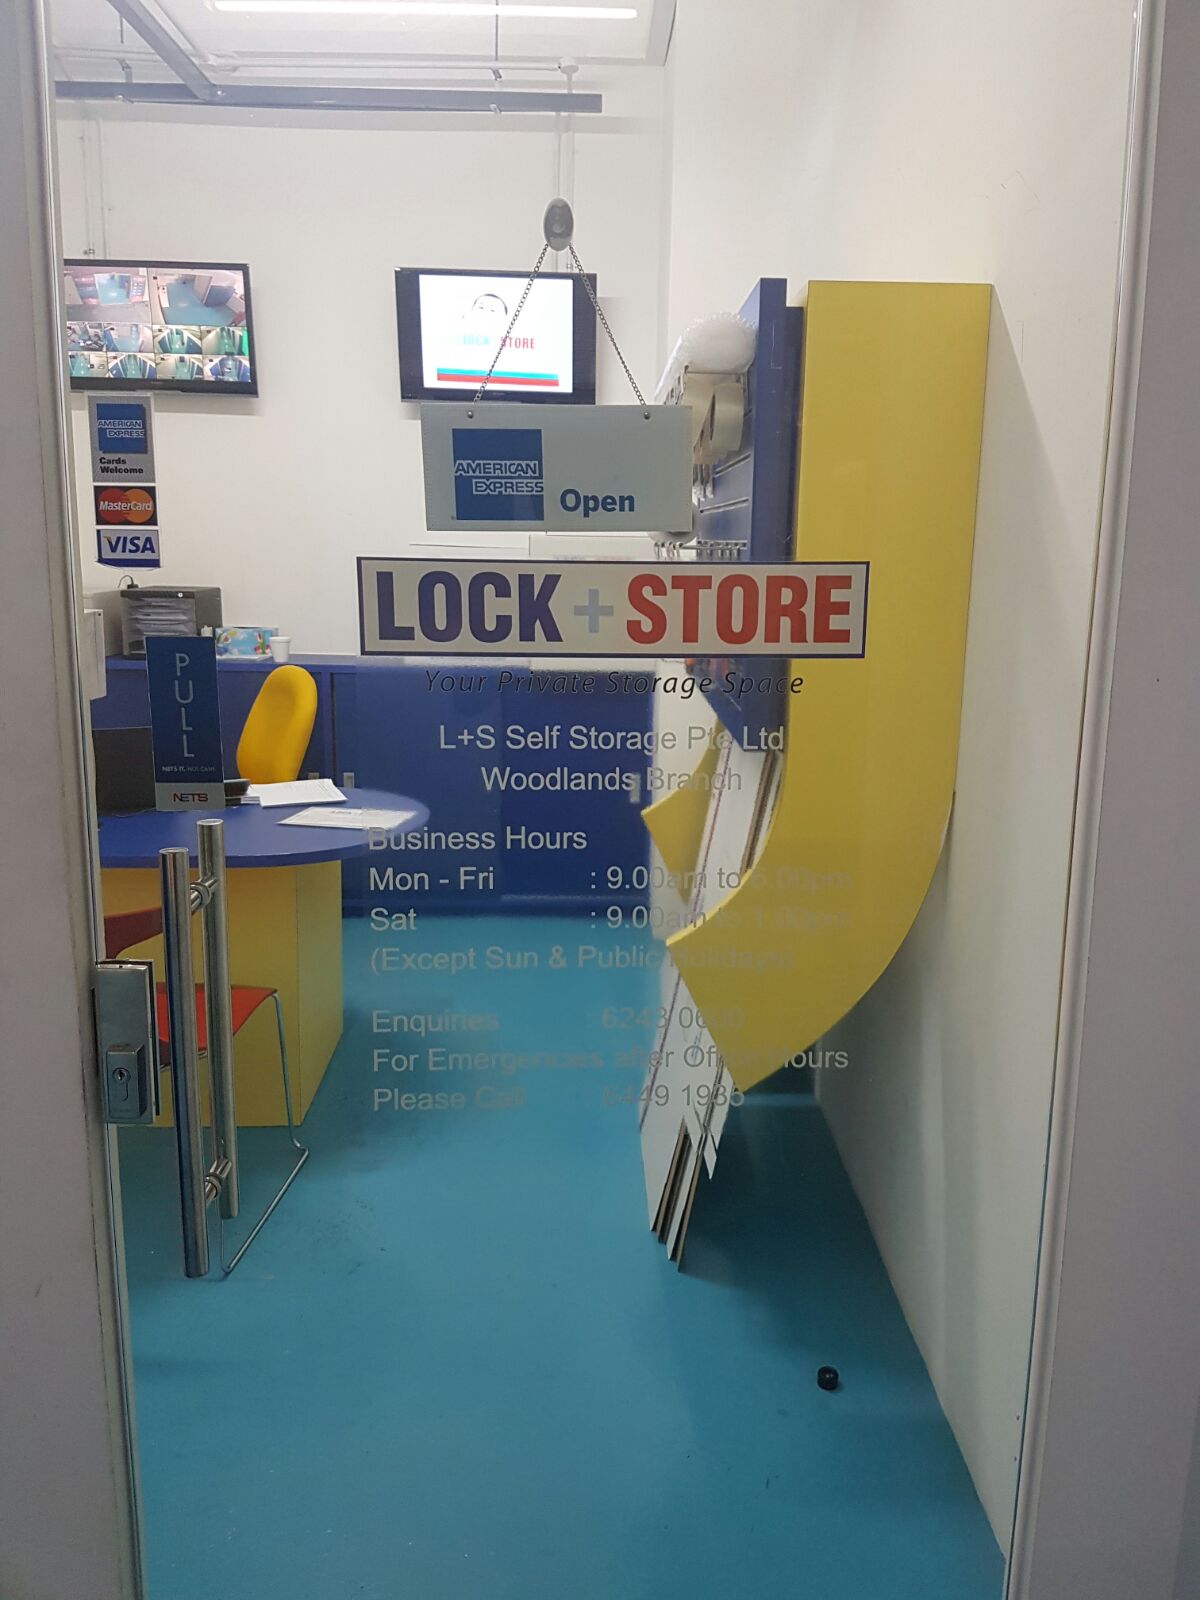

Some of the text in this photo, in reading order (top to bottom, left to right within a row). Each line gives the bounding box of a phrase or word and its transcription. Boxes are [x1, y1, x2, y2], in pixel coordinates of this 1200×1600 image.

[501, 337, 535, 350] STORE
[97, 419, 143, 429] AMERICAN
[106, 429, 145, 438] EXPRESS
[99, 456, 127, 465] Cards
[100, 466, 144, 474] Welcome
[453, 460, 540, 476] AMERICAN
[472, 479, 544, 495] EXPRESS
[99, 501, 152, 511] MasterCard
[559, 488, 635, 518] Open
[103, 535, 156, 554] VISA
[375, 570, 563, 644] LOCK
[625, 573, 853, 645] STORE
[425, 670, 804, 699] Your Private Storage Space
[174, 652, 195, 759] PULL
[438, 725, 785, 757] L+S Self Storage Pte Ltd
[480, 766, 742, 792] Woodlands Branch
[172, 792, 209, 803] NETS
[367, 825, 587, 851] Business Hours
[369, 867, 430, 891] Mon
[459, 866, 494, 890] Fri
[606, 865, 707, 890] 9.00am
[717, 867, 742, 890] to
[370, 908, 417, 931] Sat
[606, 905, 707, 930] 9.00am
[370, 947, 477, 976] (Except
[486, 946, 538, 970] Sun
[578, 944, 657, 970] Public
[373, 1048, 420, 1073] For
[373, 1087, 466, 1112] Please
